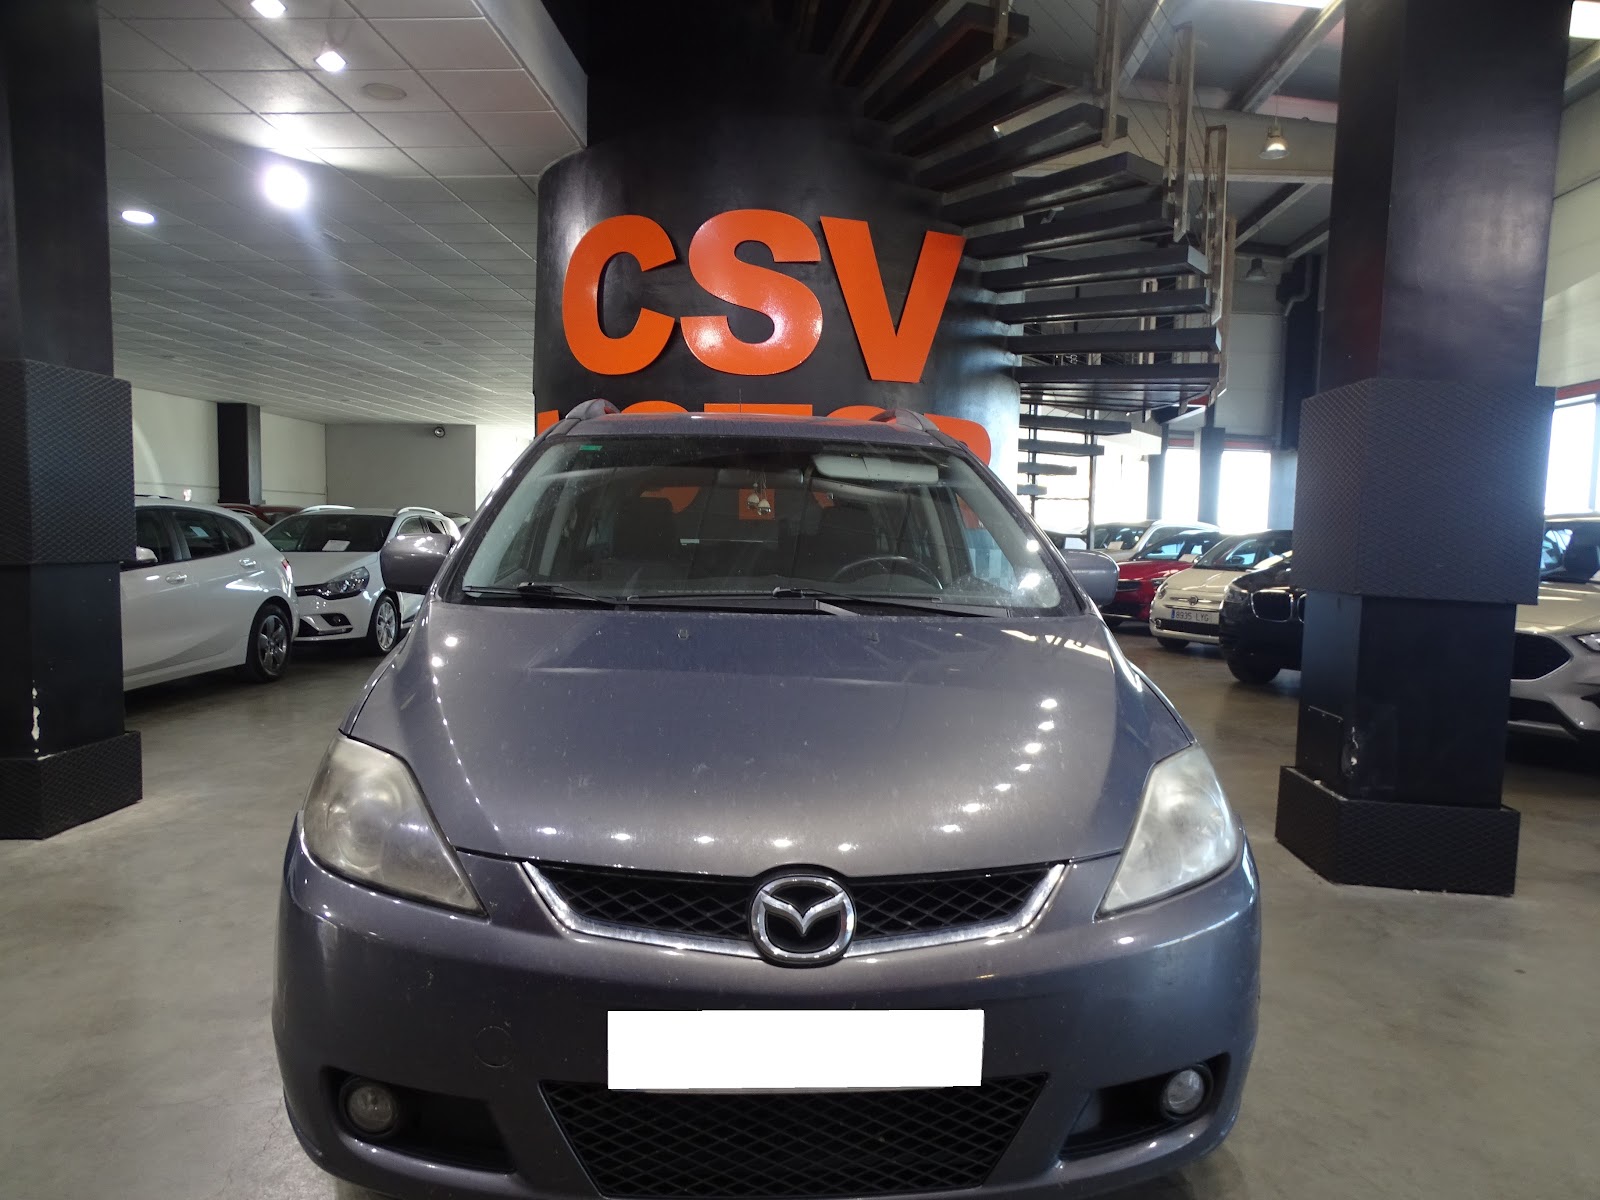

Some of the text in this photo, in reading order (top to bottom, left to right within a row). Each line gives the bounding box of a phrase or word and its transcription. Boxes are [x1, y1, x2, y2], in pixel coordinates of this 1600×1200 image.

[562, 209, 965, 383] CSV
[1175, 610, 1209, 622] 8935 LYG
